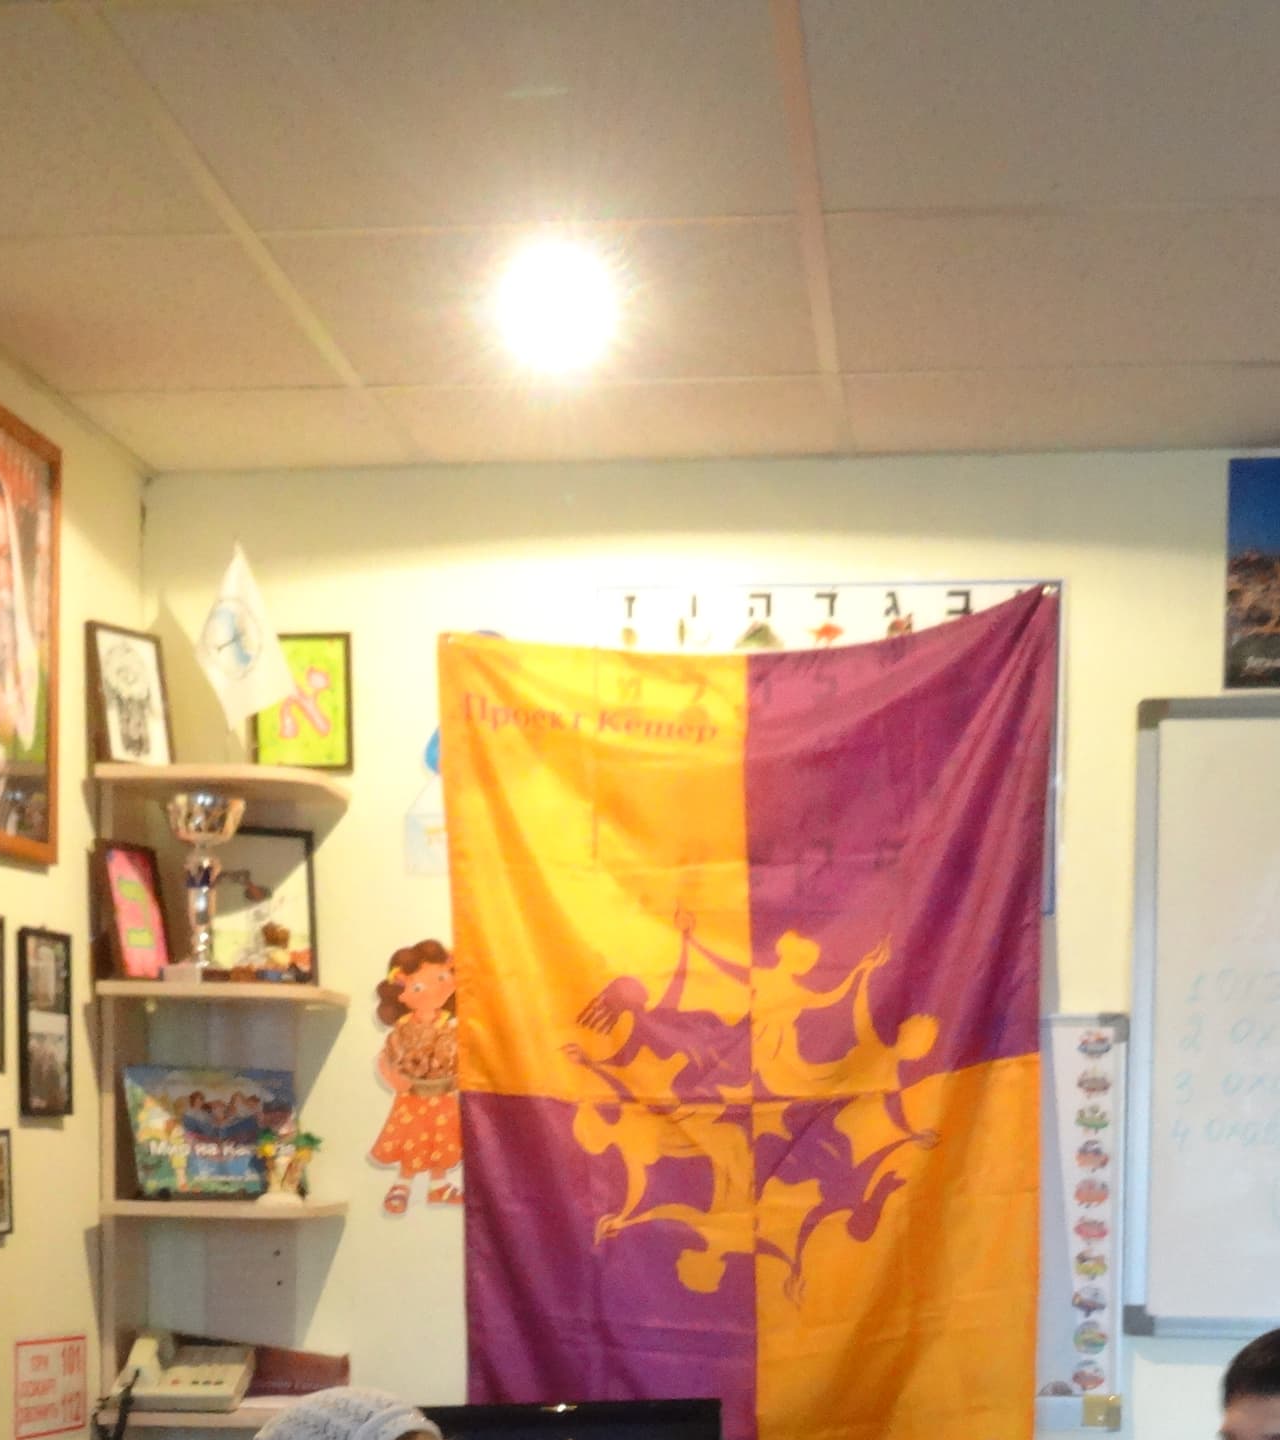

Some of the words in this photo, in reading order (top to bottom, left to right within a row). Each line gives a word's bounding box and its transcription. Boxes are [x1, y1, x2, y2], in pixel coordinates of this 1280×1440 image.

[749, 592, 772, 617] ה
[815, 592, 838, 617] ד
[463, 692, 581, 731] Проект
[597, 708, 720, 744] Кешер
